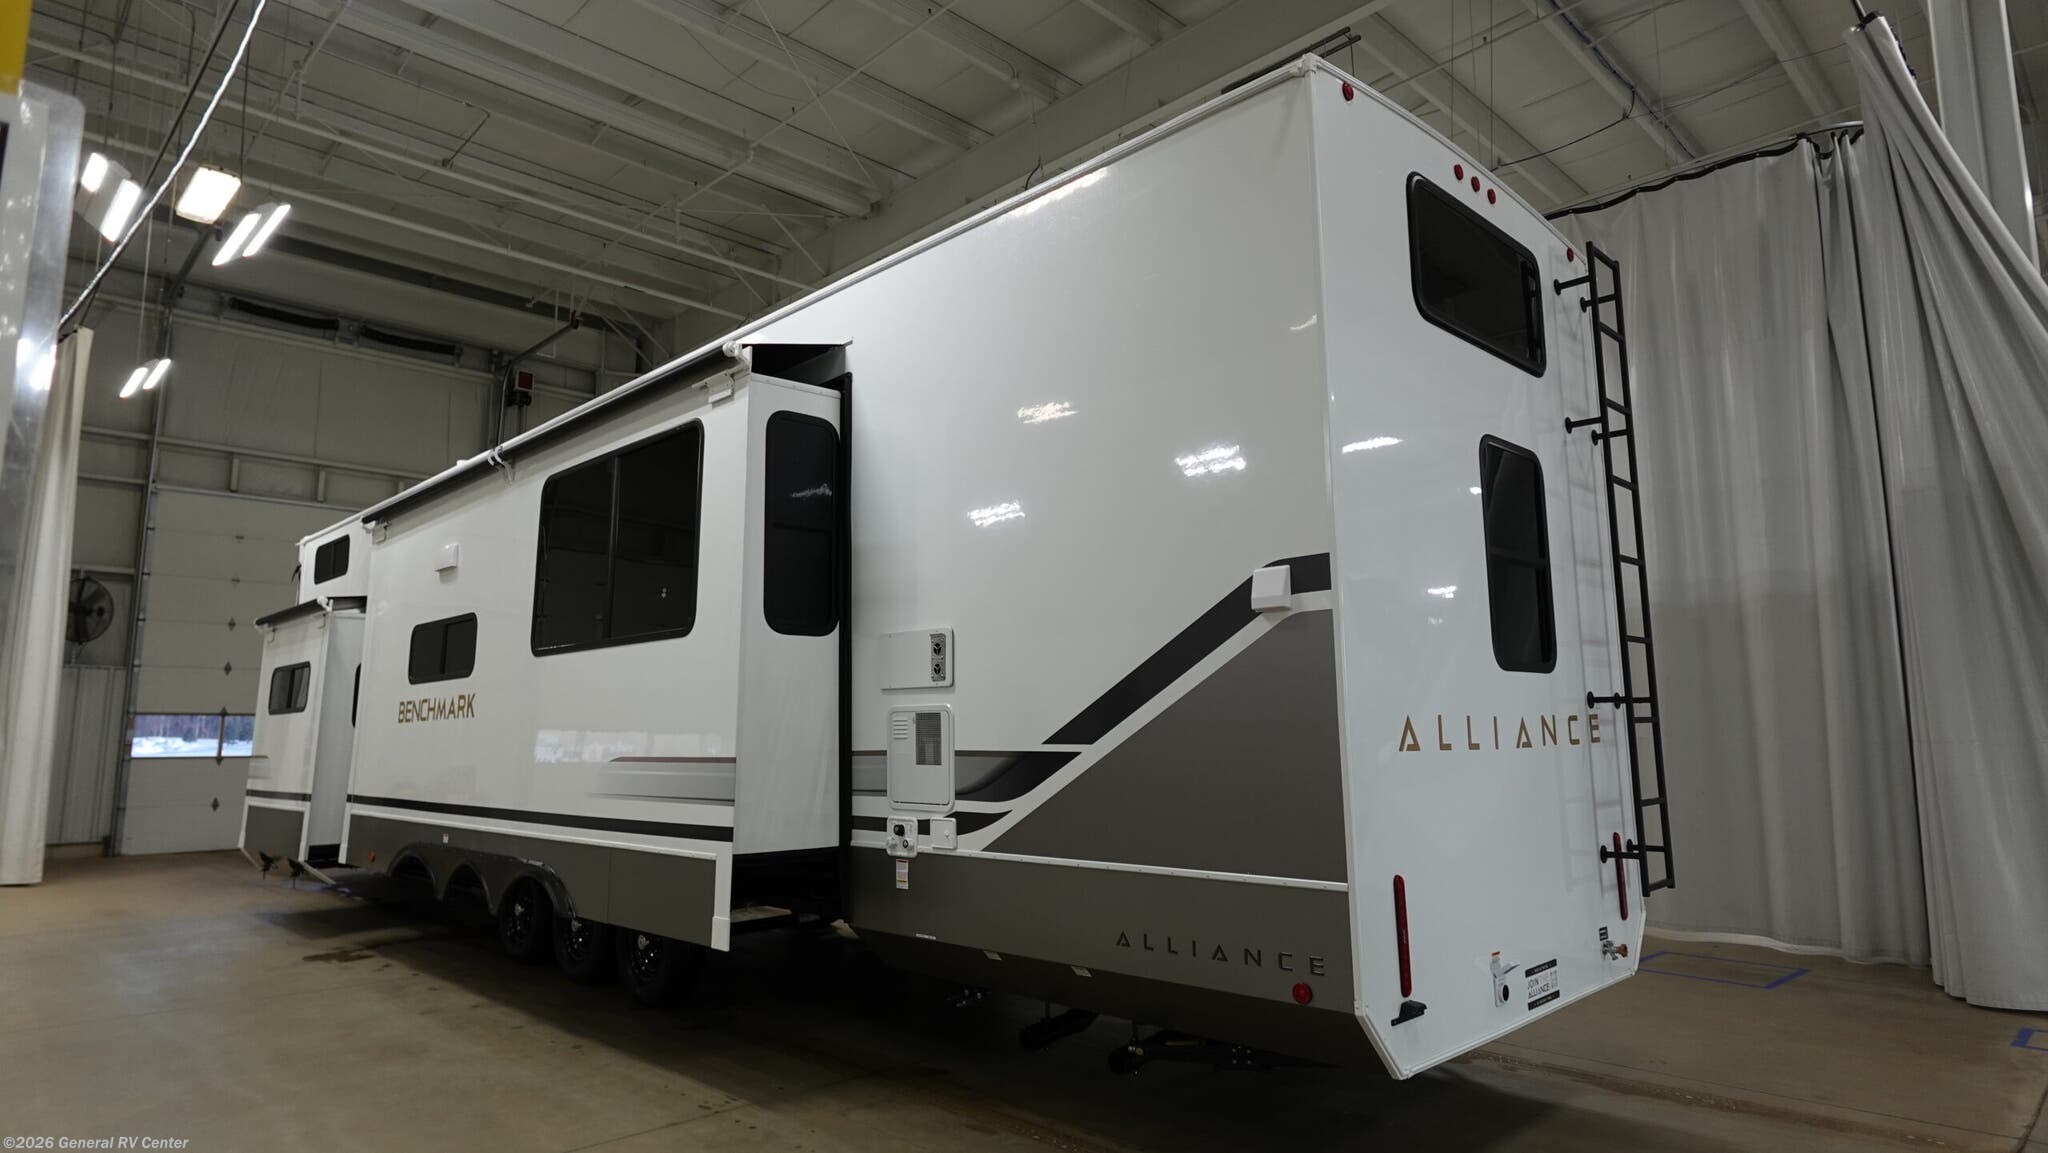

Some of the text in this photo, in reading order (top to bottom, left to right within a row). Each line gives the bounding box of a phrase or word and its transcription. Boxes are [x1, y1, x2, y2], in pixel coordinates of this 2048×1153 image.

[398, 693, 475, 724] BENCHMARK
[1399, 714, 1600, 752] ALLIANCE
[1116, 931, 1325, 976] ALLIANCE
